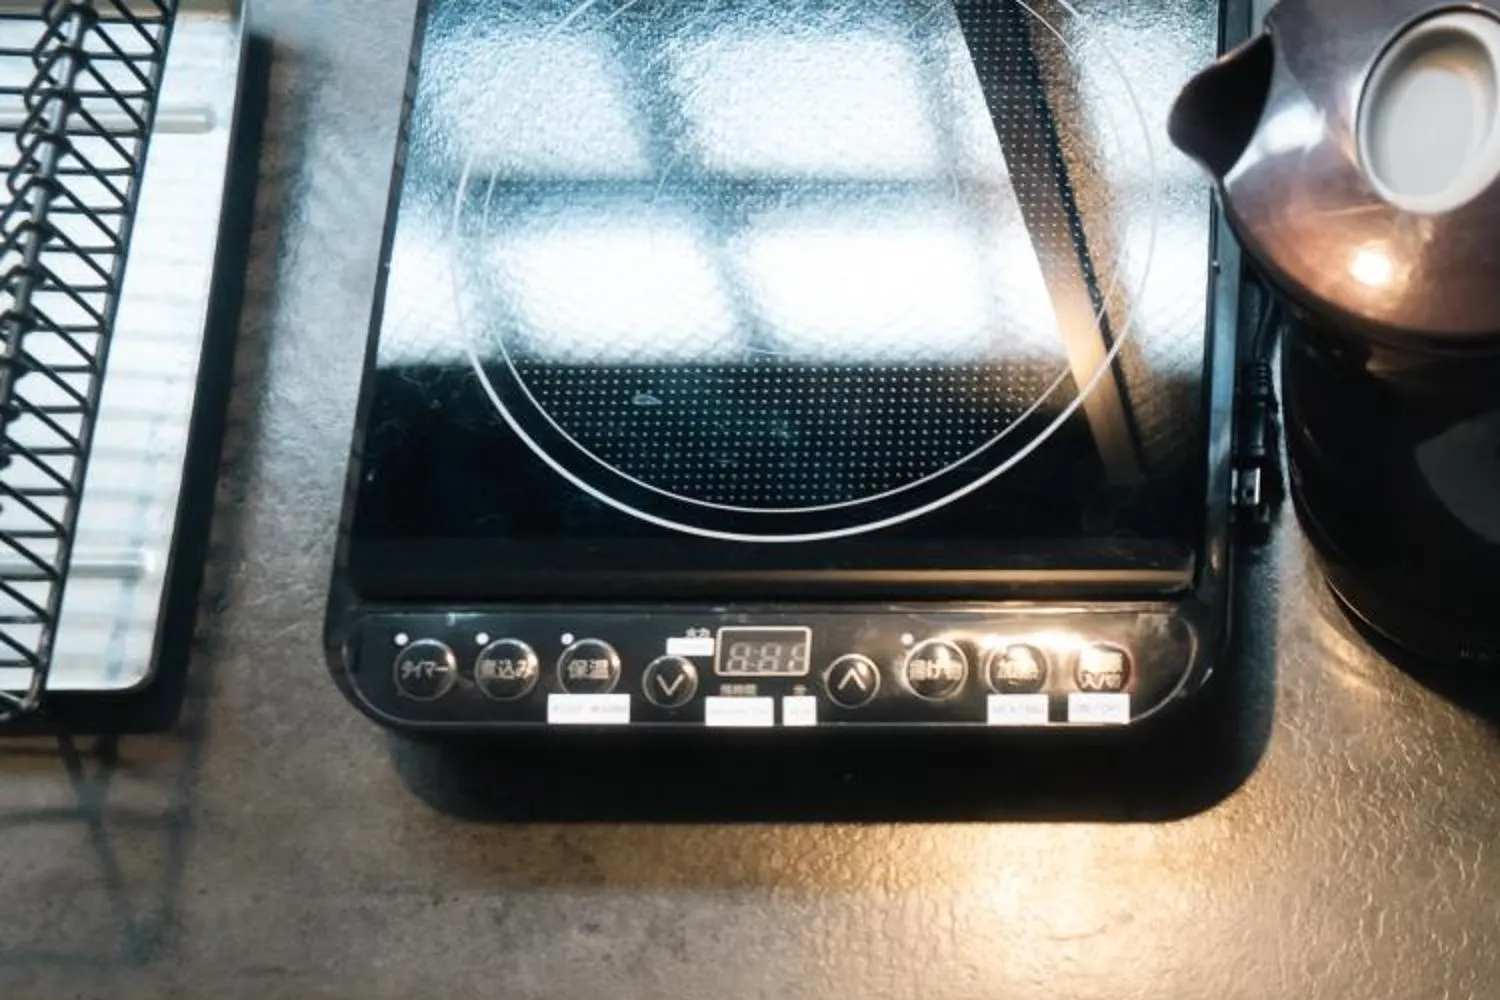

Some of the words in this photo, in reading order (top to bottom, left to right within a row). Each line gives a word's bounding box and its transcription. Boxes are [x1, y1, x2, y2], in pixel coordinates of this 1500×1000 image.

[400, 658, 450, 680] タイマー
[567, 658, 609, 681] 保温
